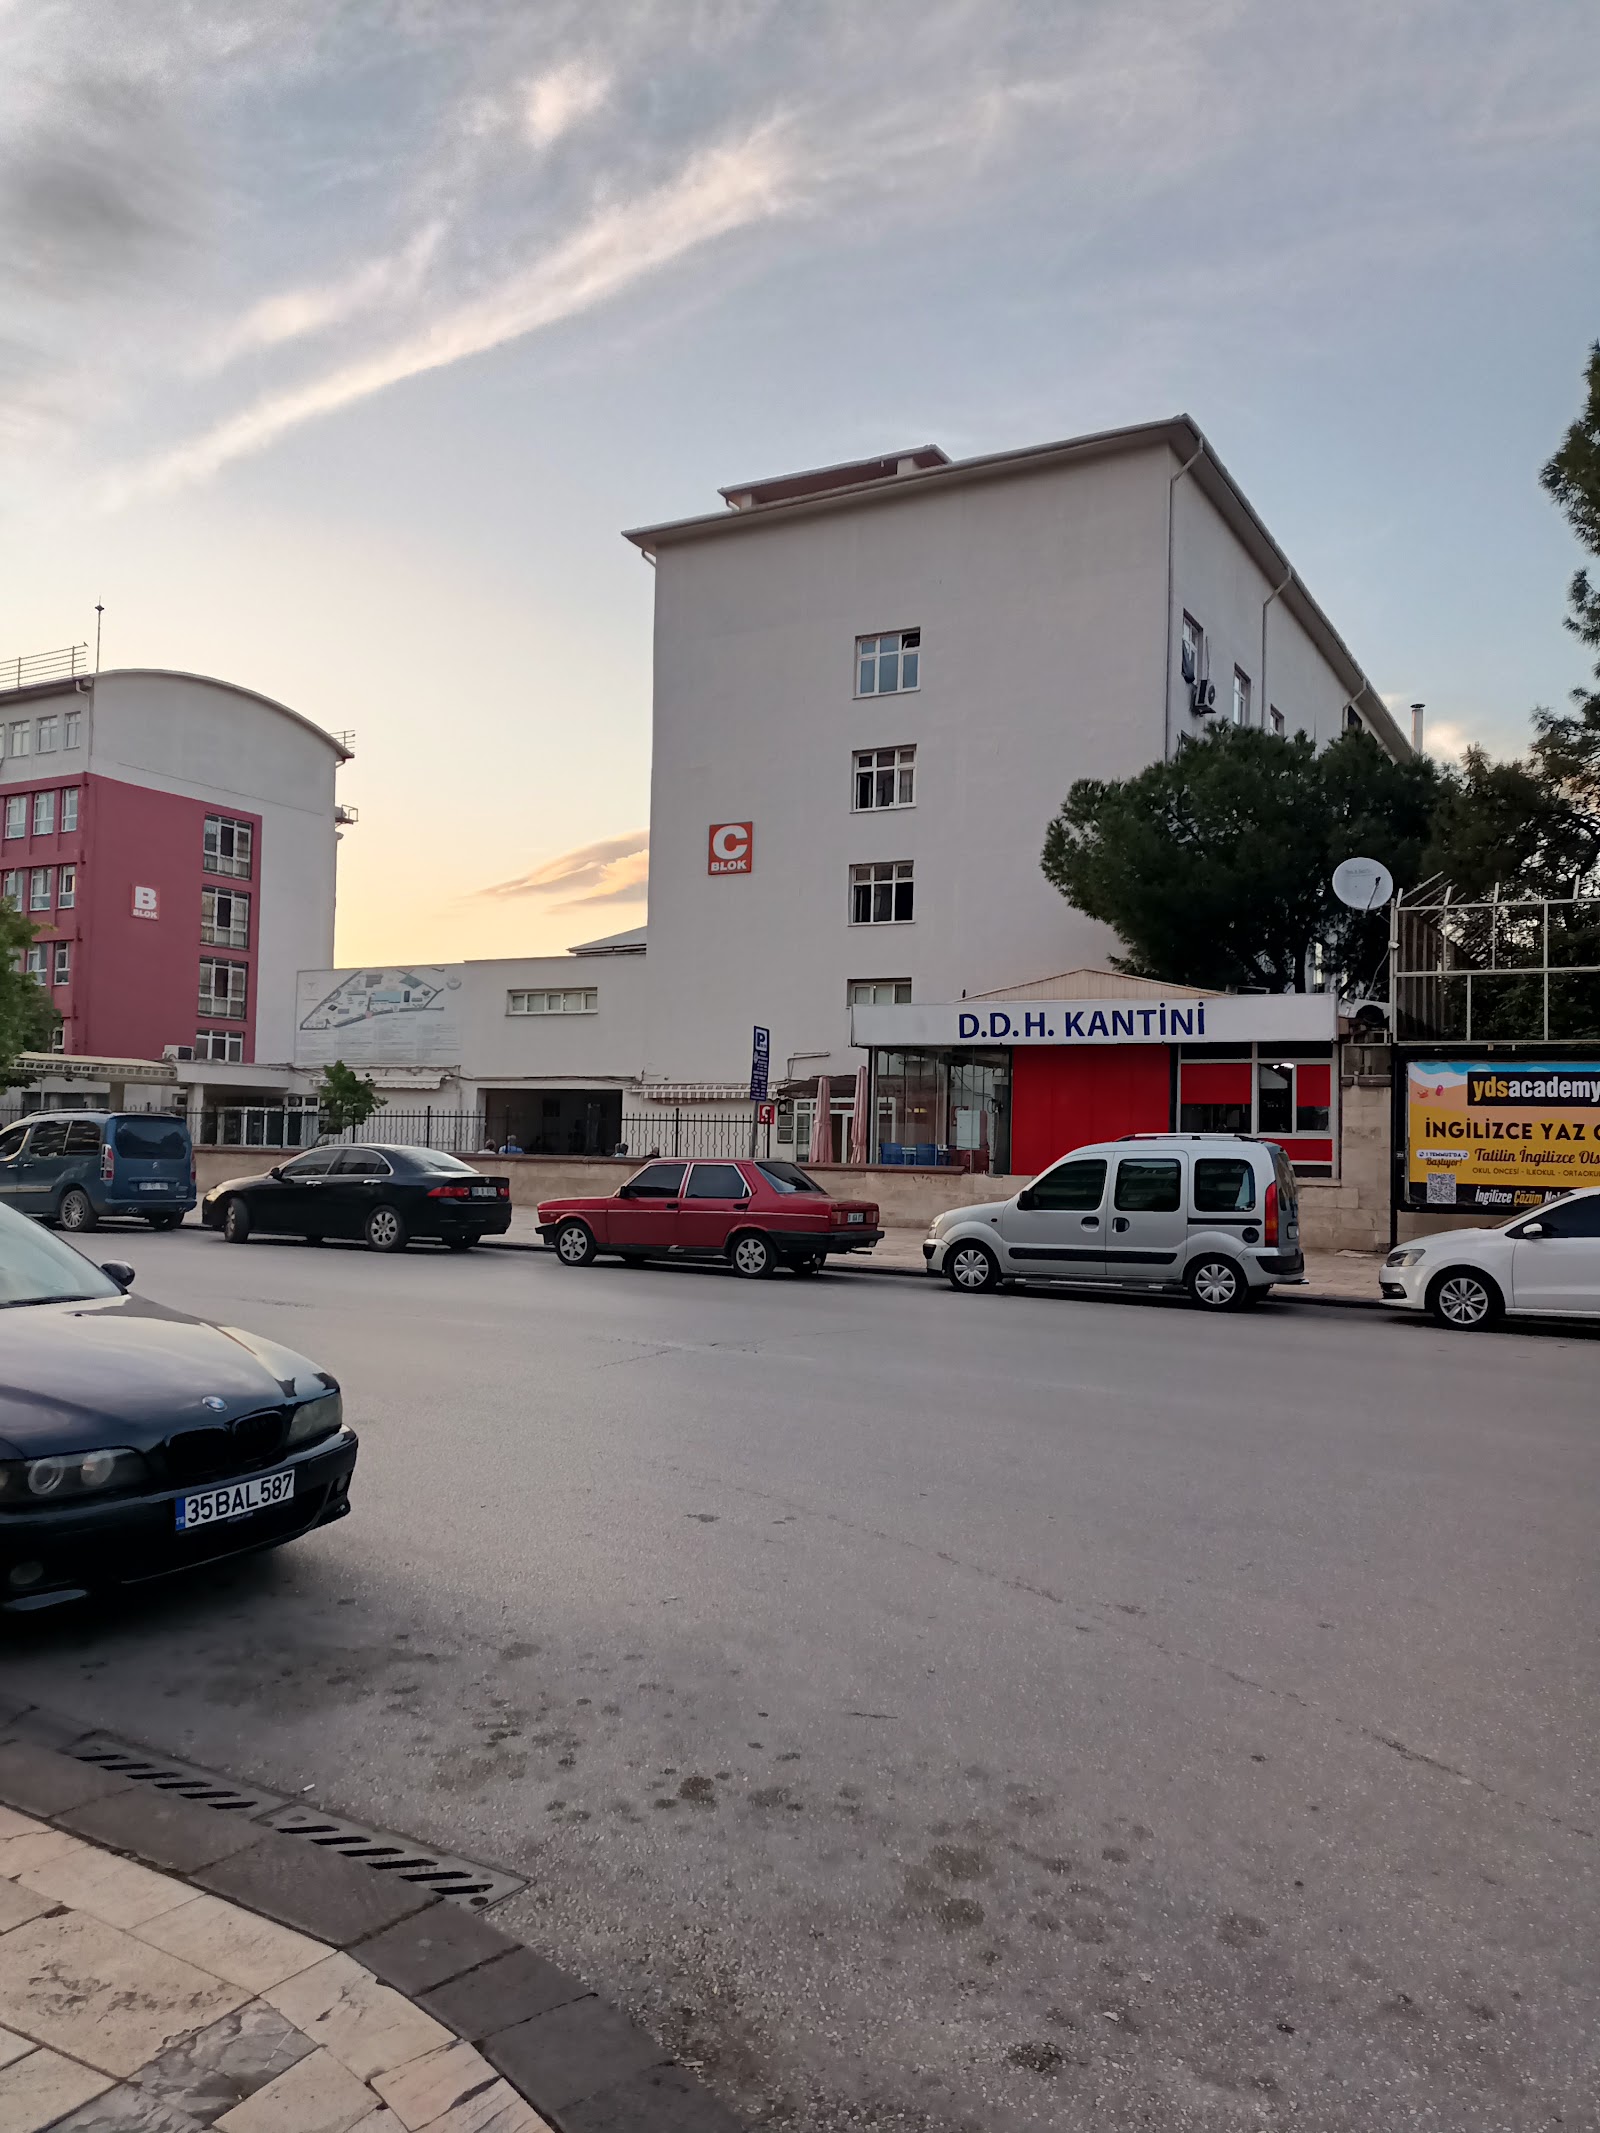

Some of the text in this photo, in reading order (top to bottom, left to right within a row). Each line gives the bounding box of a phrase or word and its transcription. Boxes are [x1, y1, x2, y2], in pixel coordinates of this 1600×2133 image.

[713, 825, 748, 860] C
[711, 860, 747, 871] BLOK
[135, 886, 157, 910] B
[133, 909, 158, 919] BLOK
[958, 1002, 1205, 1039] D.D.H. KANTİNİ
[757, 1032, 766, 1047] P
[1473, 1076, 1600, 1103] ydsacademy
[1425, 1117, 1533, 1140] İNGİLİZCE
[1540, 1123, 1586, 1141] YAZ
[1519, 1146, 1575, 1167] İngilizce
[1472, 1167, 1491, 1175] OKUL
[1475, 1186, 1513, 1206] İngilizce
[1514, 1189, 1543, 1207] Çözüm
